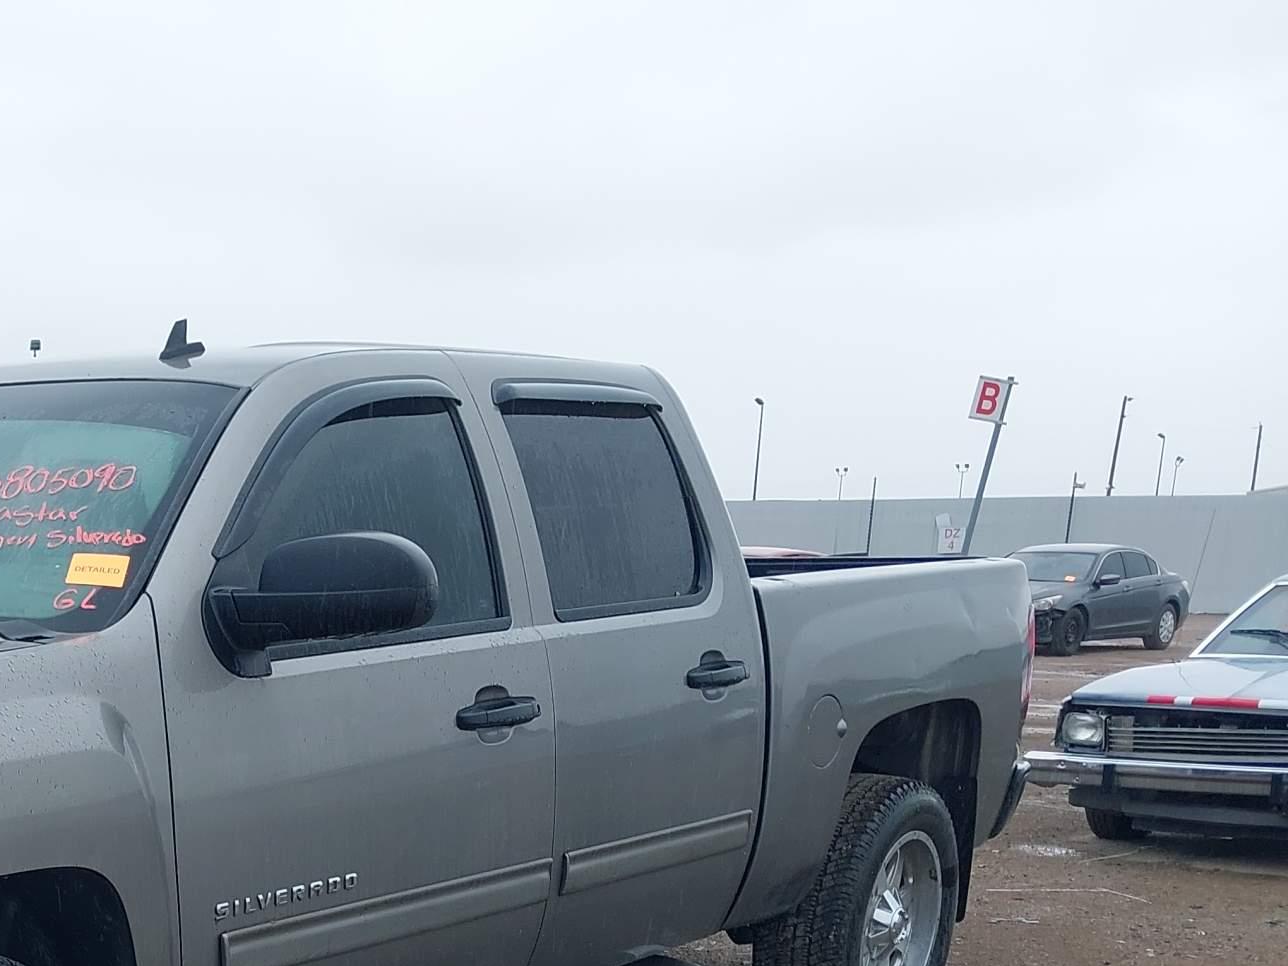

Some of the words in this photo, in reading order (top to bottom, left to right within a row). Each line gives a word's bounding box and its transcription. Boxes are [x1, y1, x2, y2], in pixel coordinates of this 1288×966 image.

[976, 381, 1001, 415] B
[74, 565, 121, 574] DETAILED
[214, 872, 358, 921] SILVERADO
